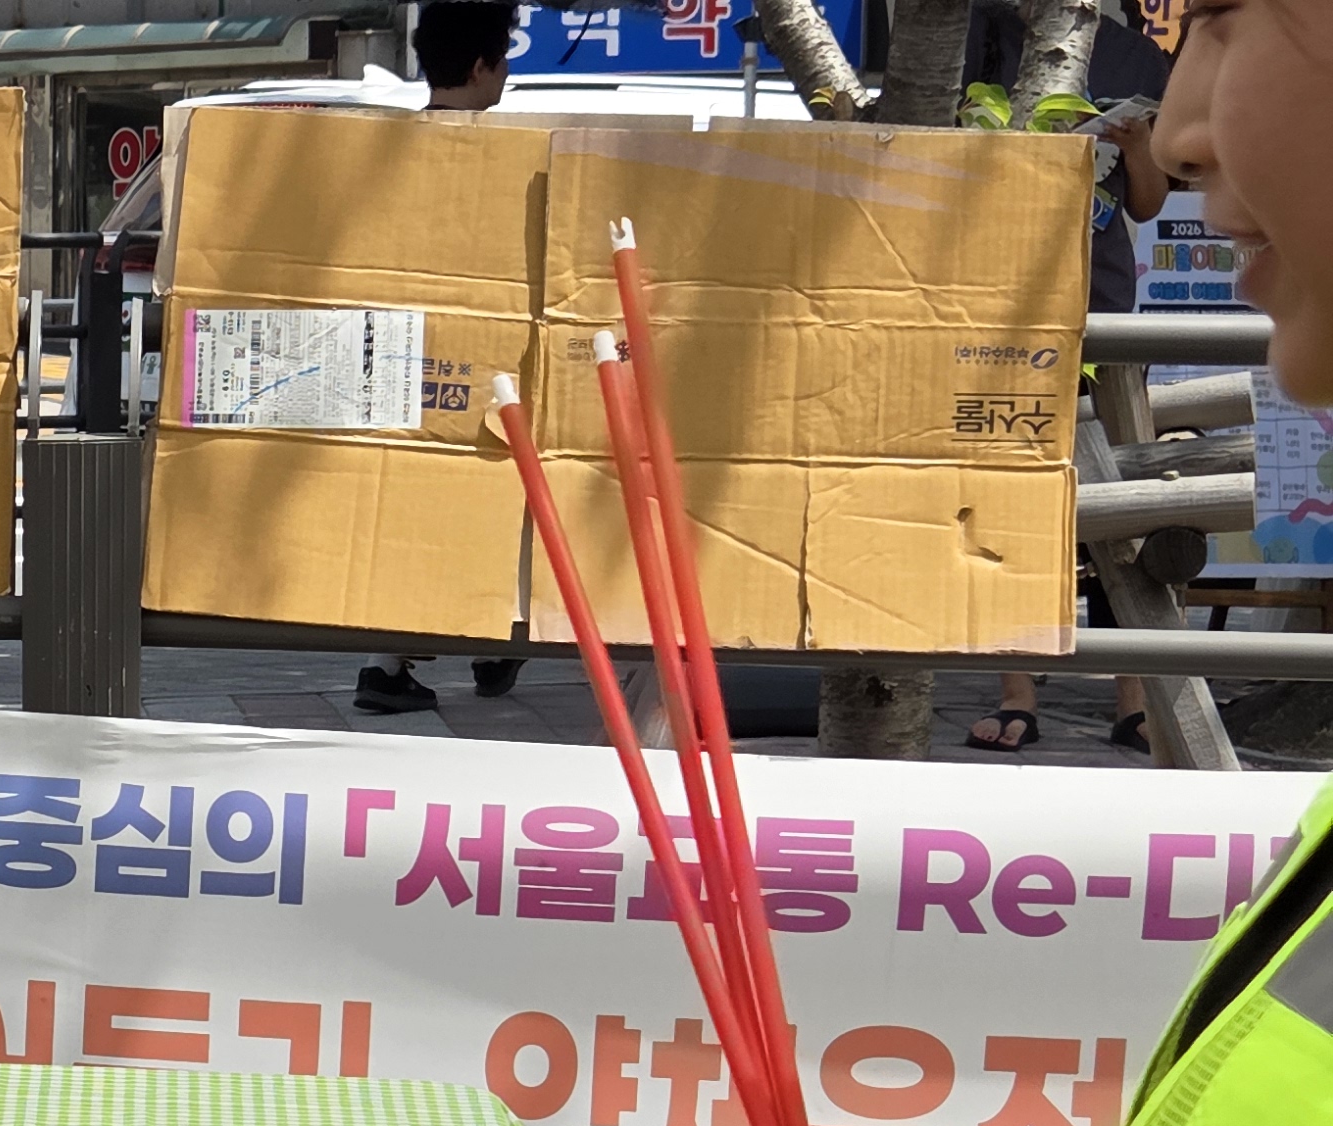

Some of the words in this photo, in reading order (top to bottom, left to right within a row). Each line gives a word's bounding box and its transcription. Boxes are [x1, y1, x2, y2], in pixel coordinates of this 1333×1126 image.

[1171, 223, 1201, 236] 2026
[951, 400, 1055, 435] 수산물
[896, 828, 1299, 942] Re-디
